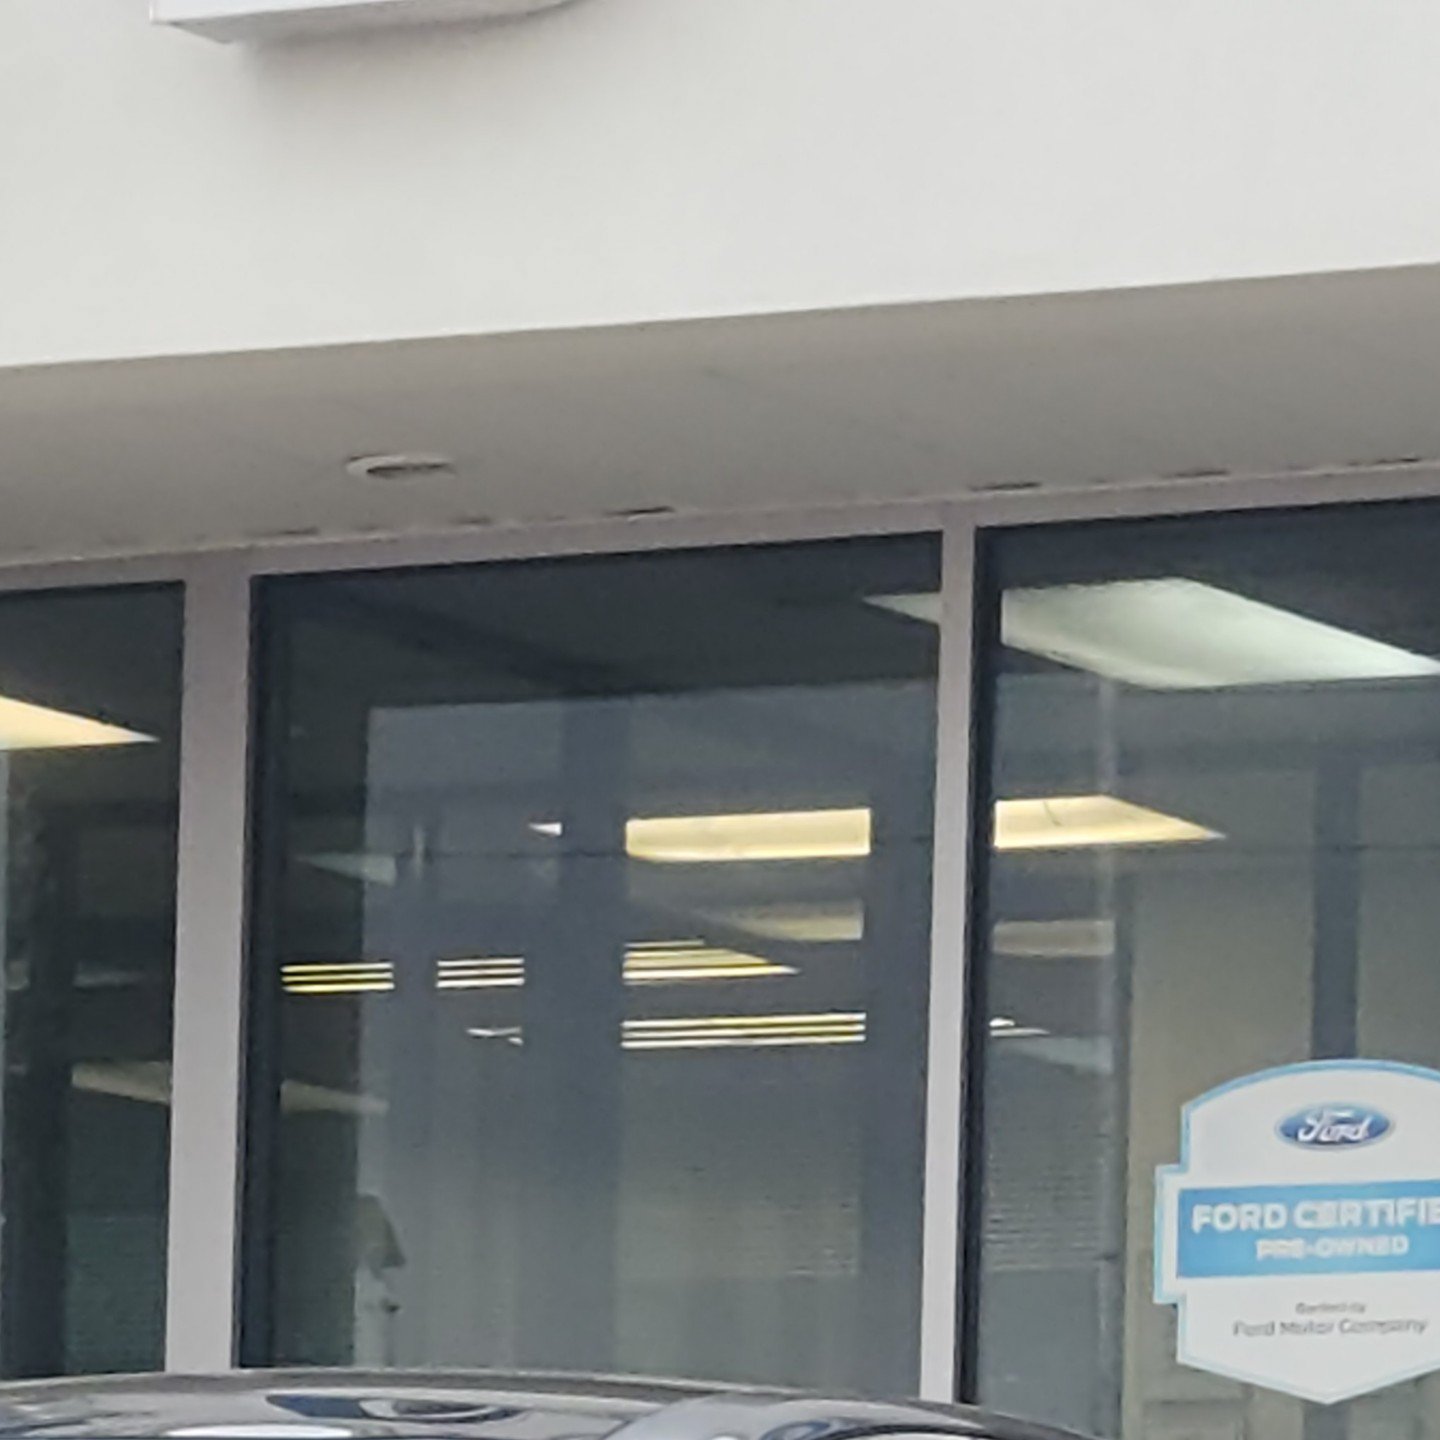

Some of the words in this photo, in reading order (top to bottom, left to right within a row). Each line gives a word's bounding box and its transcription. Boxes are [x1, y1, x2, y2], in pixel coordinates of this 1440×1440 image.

[1298, 1108, 1373, 1142] Ford
[1192, 1203, 1288, 1233] FORD
[1256, 1235, 1409, 1260] PRE-OWNED
